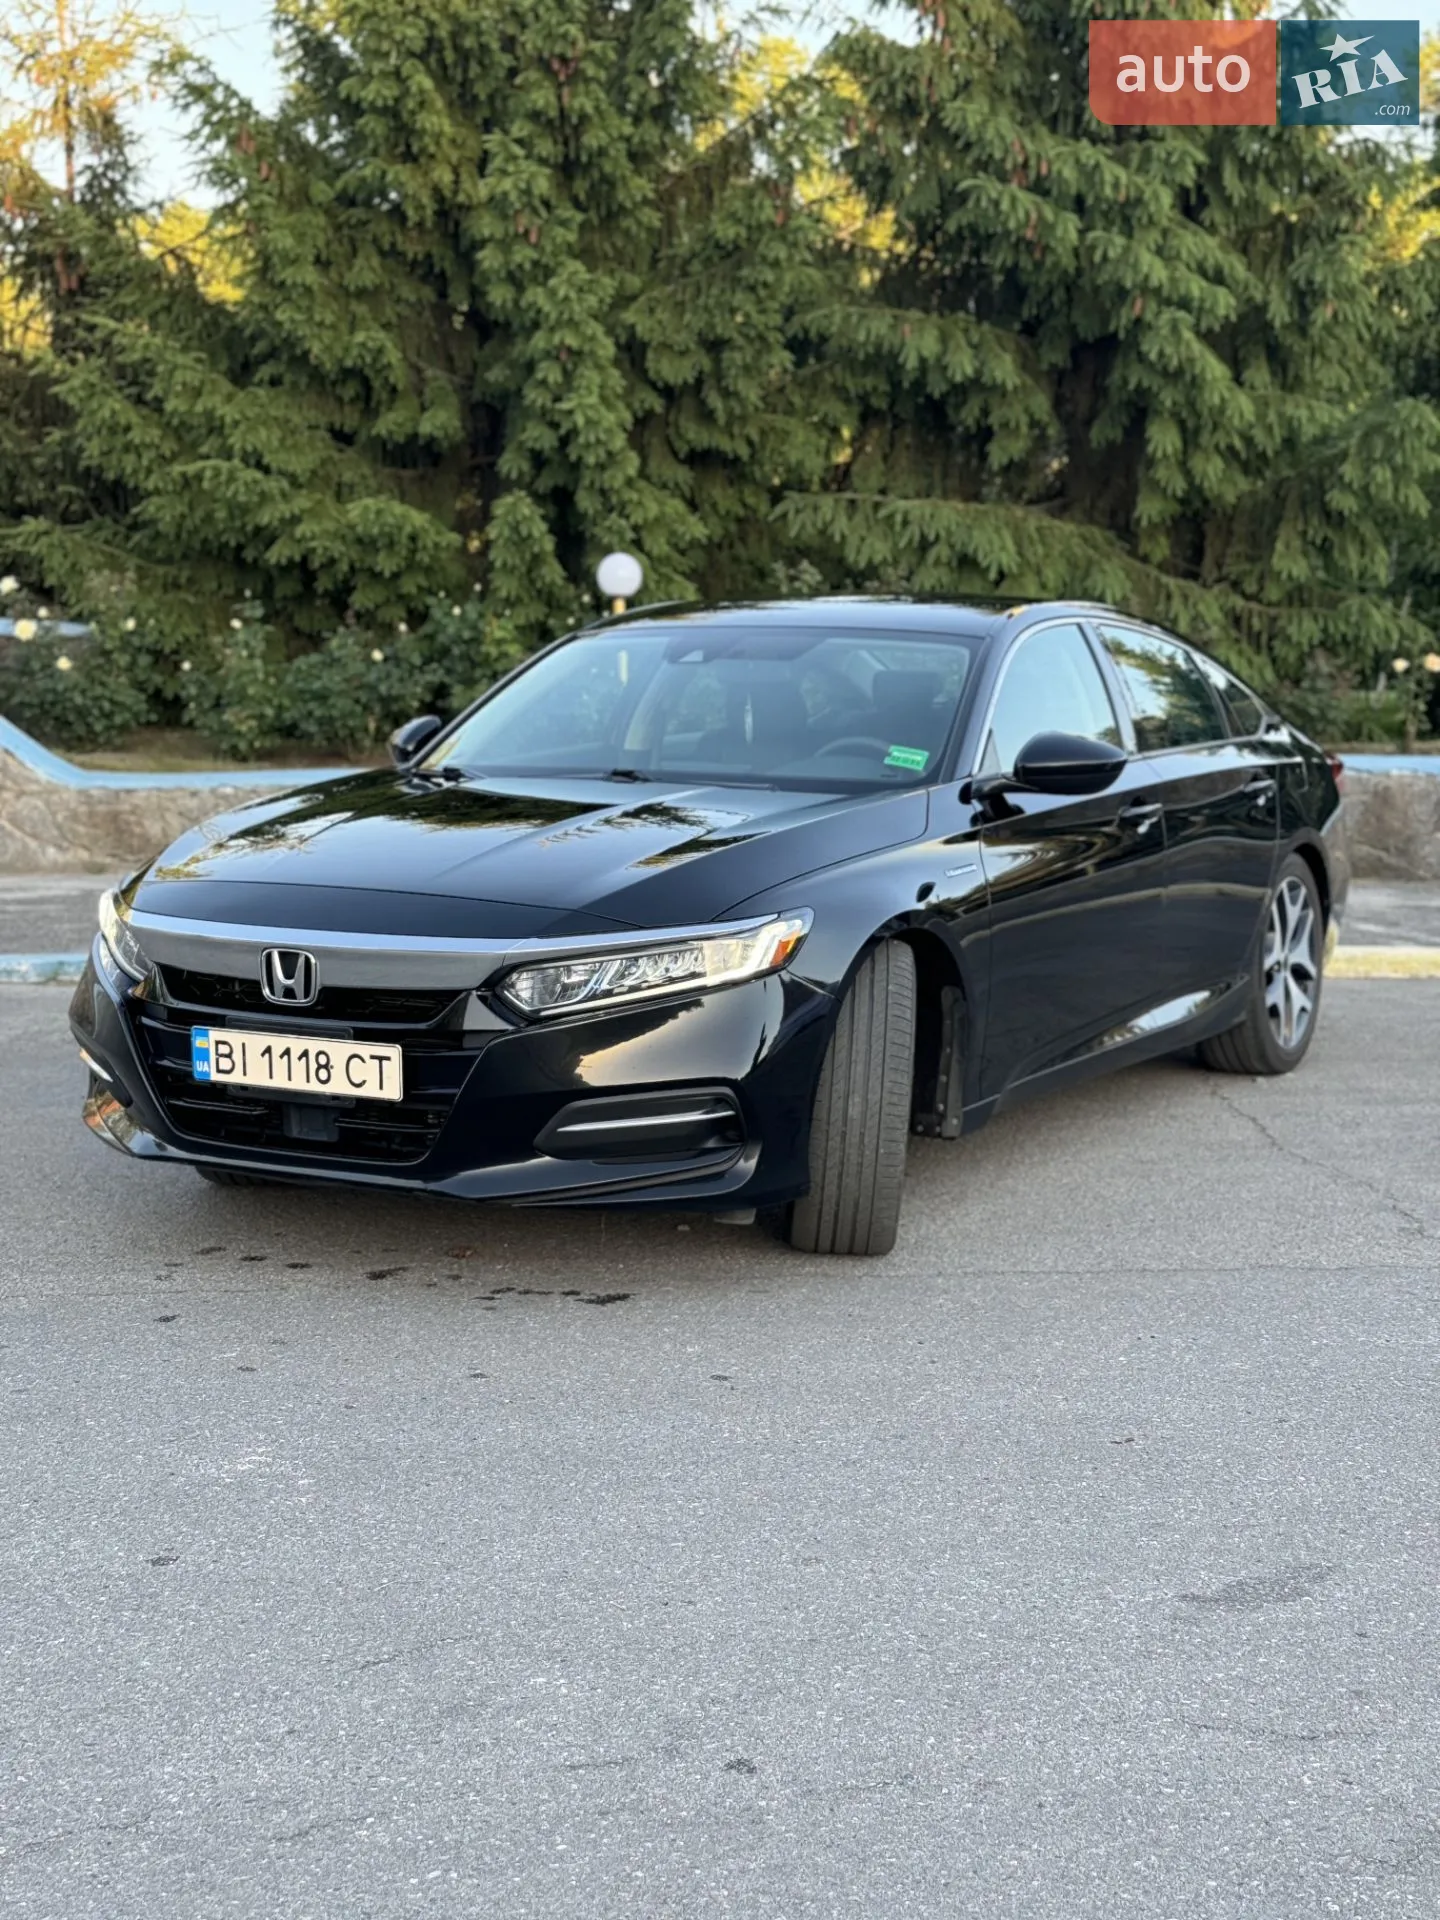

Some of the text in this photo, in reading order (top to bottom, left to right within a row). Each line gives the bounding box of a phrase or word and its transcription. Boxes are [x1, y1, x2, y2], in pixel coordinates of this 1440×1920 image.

[196, 1060, 209, 1073] UA
[214, 1039, 392, 1092] BI 1118 CT
